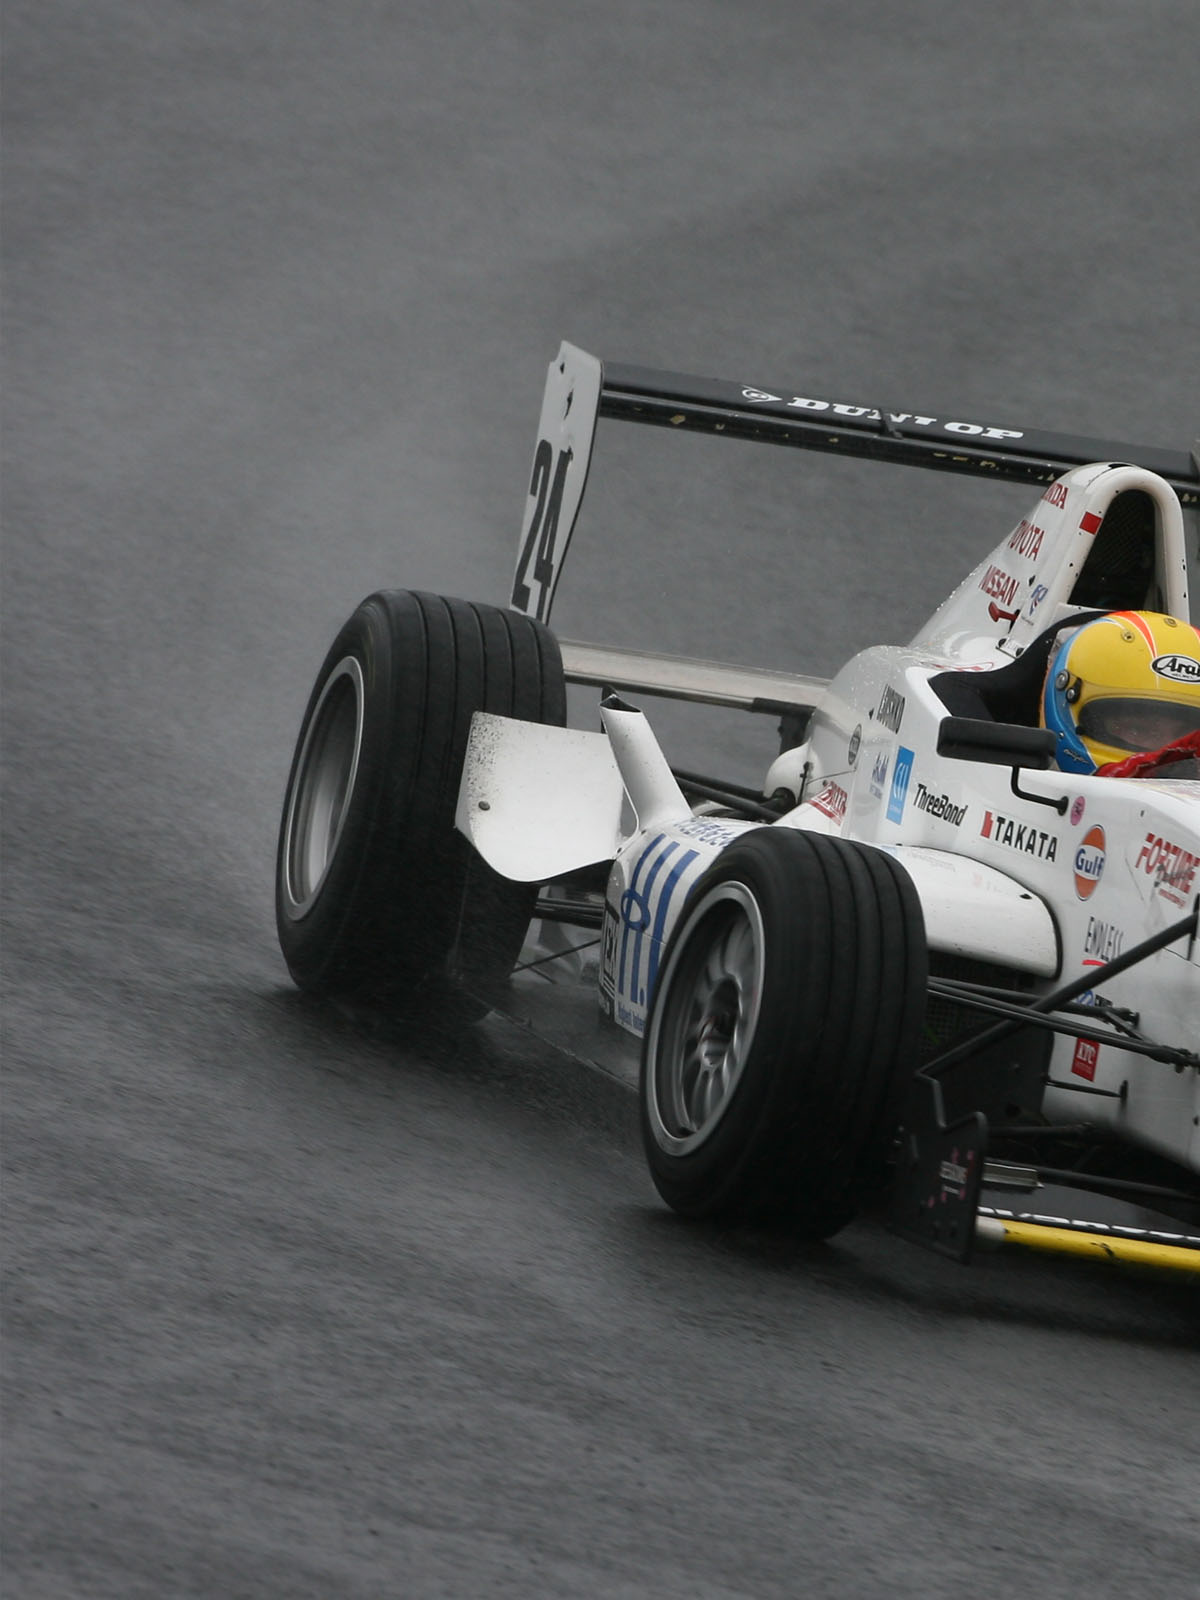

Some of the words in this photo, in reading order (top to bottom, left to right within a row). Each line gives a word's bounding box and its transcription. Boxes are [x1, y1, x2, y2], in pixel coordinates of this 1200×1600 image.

[511, 438, 574, 624] 24
[978, 564, 1021, 607] NISSAN
[913, 783, 969, 827] ThreeBond
[994, 815, 1059, 863] TAKATA
[1075, 847, 1105, 878] Gulf
